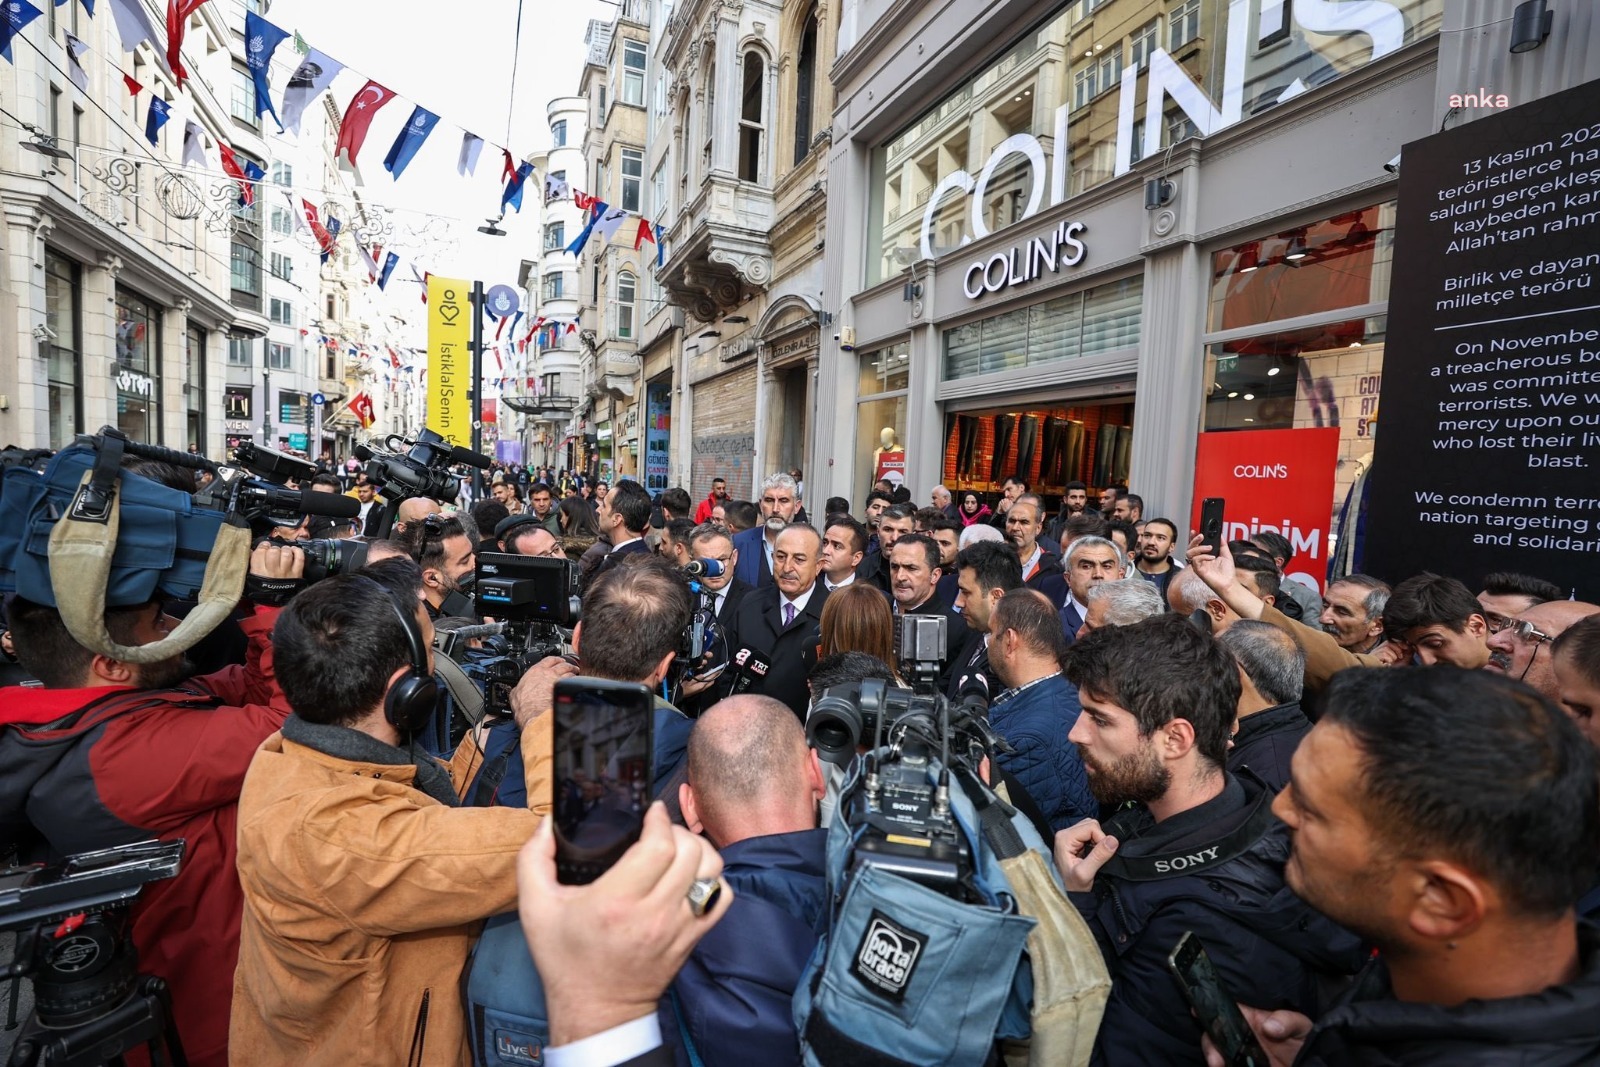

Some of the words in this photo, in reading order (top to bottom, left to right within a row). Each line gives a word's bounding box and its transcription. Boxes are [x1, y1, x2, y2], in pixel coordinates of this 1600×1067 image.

[1464, 160, 1482, 176] 13
[1488, 141, 1553, 169] Kasım
[1438, 158, 1562, 201] teröristlerce
[1570, 148, 1599, 166] ha
[1429, 199, 1486, 222] saldırı
[1492, 168, 1600, 210] gerçekleş
[1454, 200, 1556, 234] kaybeden
[1446, 226, 1536, 254] Allah'tan
[964, 220, 1088, 299] COLIN'S
[1444, 270, 1494, 291] Birlik
[1500, 266, 1523, 281] ve
[1529, 253, 1600, 276] dayan
[1436, 288, 1515, 311] milletçe
[1520, 273, 1592, 298] terörü
[1455, 342, 1483, 356] On
[1490, 329, 1599, 352] Novembe
[1430, 366, 1440, 376] a
[1446, 351, 1572, 375] treacherous
[1450, 381, 1488, 393] was
[1493, 370, 1600, 390] committe
[1361, 396, 1377, 415] AT
[1438, 397, 1532, 412] terrorists.
[1540, 392, 1577, 406] We
[1438, 418, 1499, 432] mercy
[1505, 415, 1562, 430] upon
[1570, 414, 1600, 426] ou
[1432, 436, 1473, 449] who
[1480, 435, 1515, 448] lost
[1522, 432, 1576, 448] their
[1234, 463, 1288, 478] COLIN'S
[1528, 454, 1589, 468] blast.
[1414, 492, 1444, 504] We
[1448, 493, 1546, 508] condemn
[1420, 511, 1478, 524] nation
[1485, 512, 1588, 534] targeting
[1473, 532, 1512, 546] and
[754, 660, 768, 671] TRT
[892, 802, 919, 812] SONY
[1154, 846, 1219, 872] SONY
[868, 928, 911, 970] porta
[863, 950, 904, 982] brace
